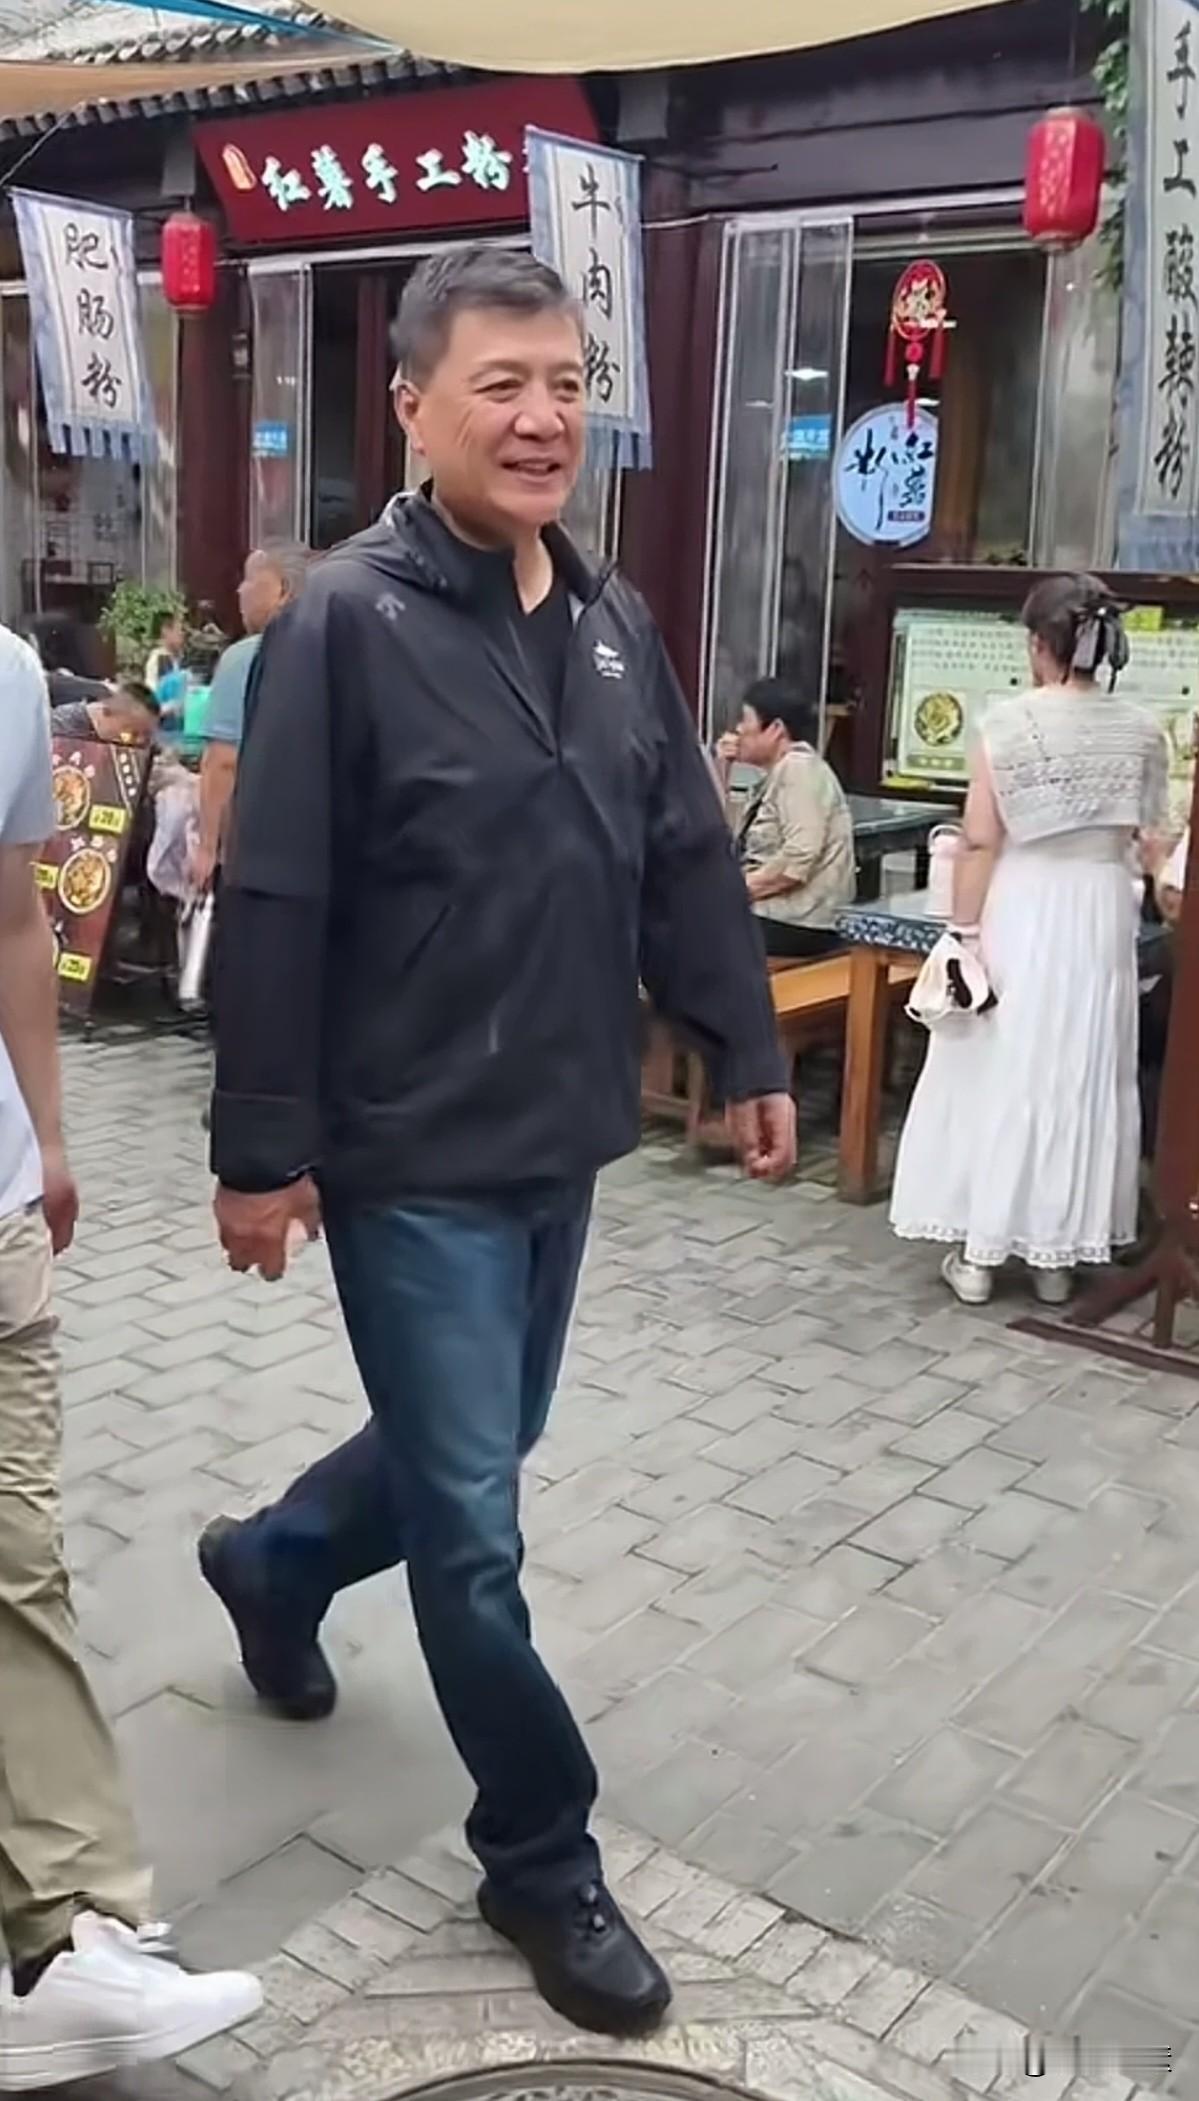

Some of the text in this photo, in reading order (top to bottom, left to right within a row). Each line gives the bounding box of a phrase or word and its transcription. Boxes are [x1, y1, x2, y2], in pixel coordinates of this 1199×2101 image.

[261, 130, 528, 211] 红薯手工粉
[63, 222, 123, 409] 肥肠粉
[571, 161, 622, 403] 牛肉粉
